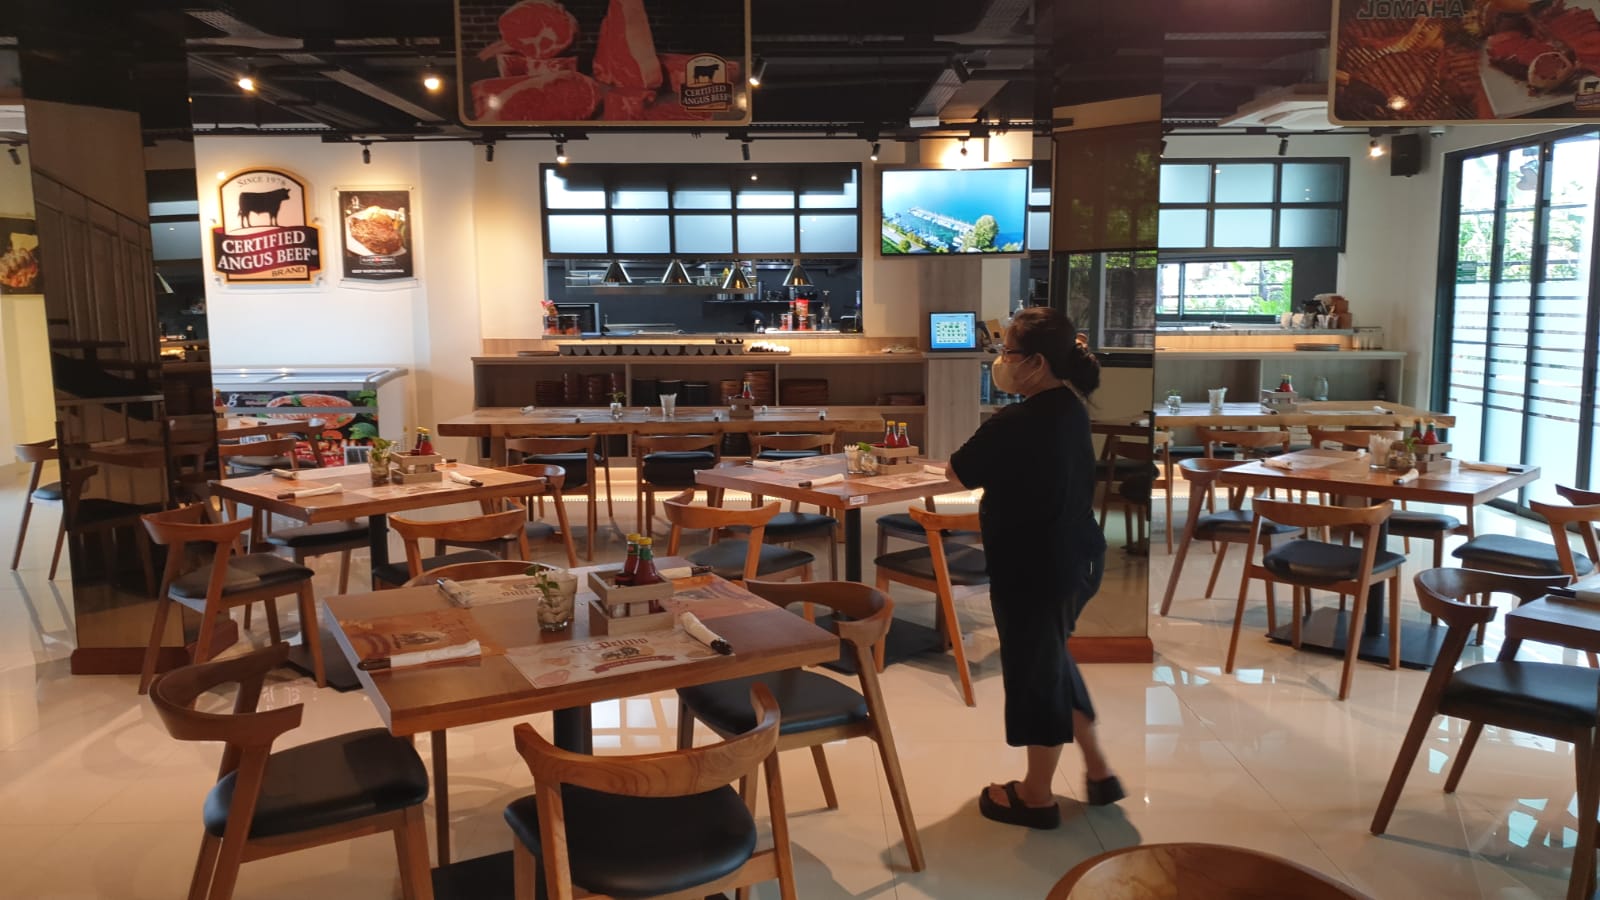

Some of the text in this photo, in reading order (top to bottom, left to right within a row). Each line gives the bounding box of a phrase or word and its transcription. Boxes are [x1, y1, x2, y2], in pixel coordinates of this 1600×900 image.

[237, 176, 263, 187] SINCE
[222, 230, 305, 254] CERTIFIED
[217, 252, 273, 271] ANGUS
[271, 266, 306, 277] BRAND
